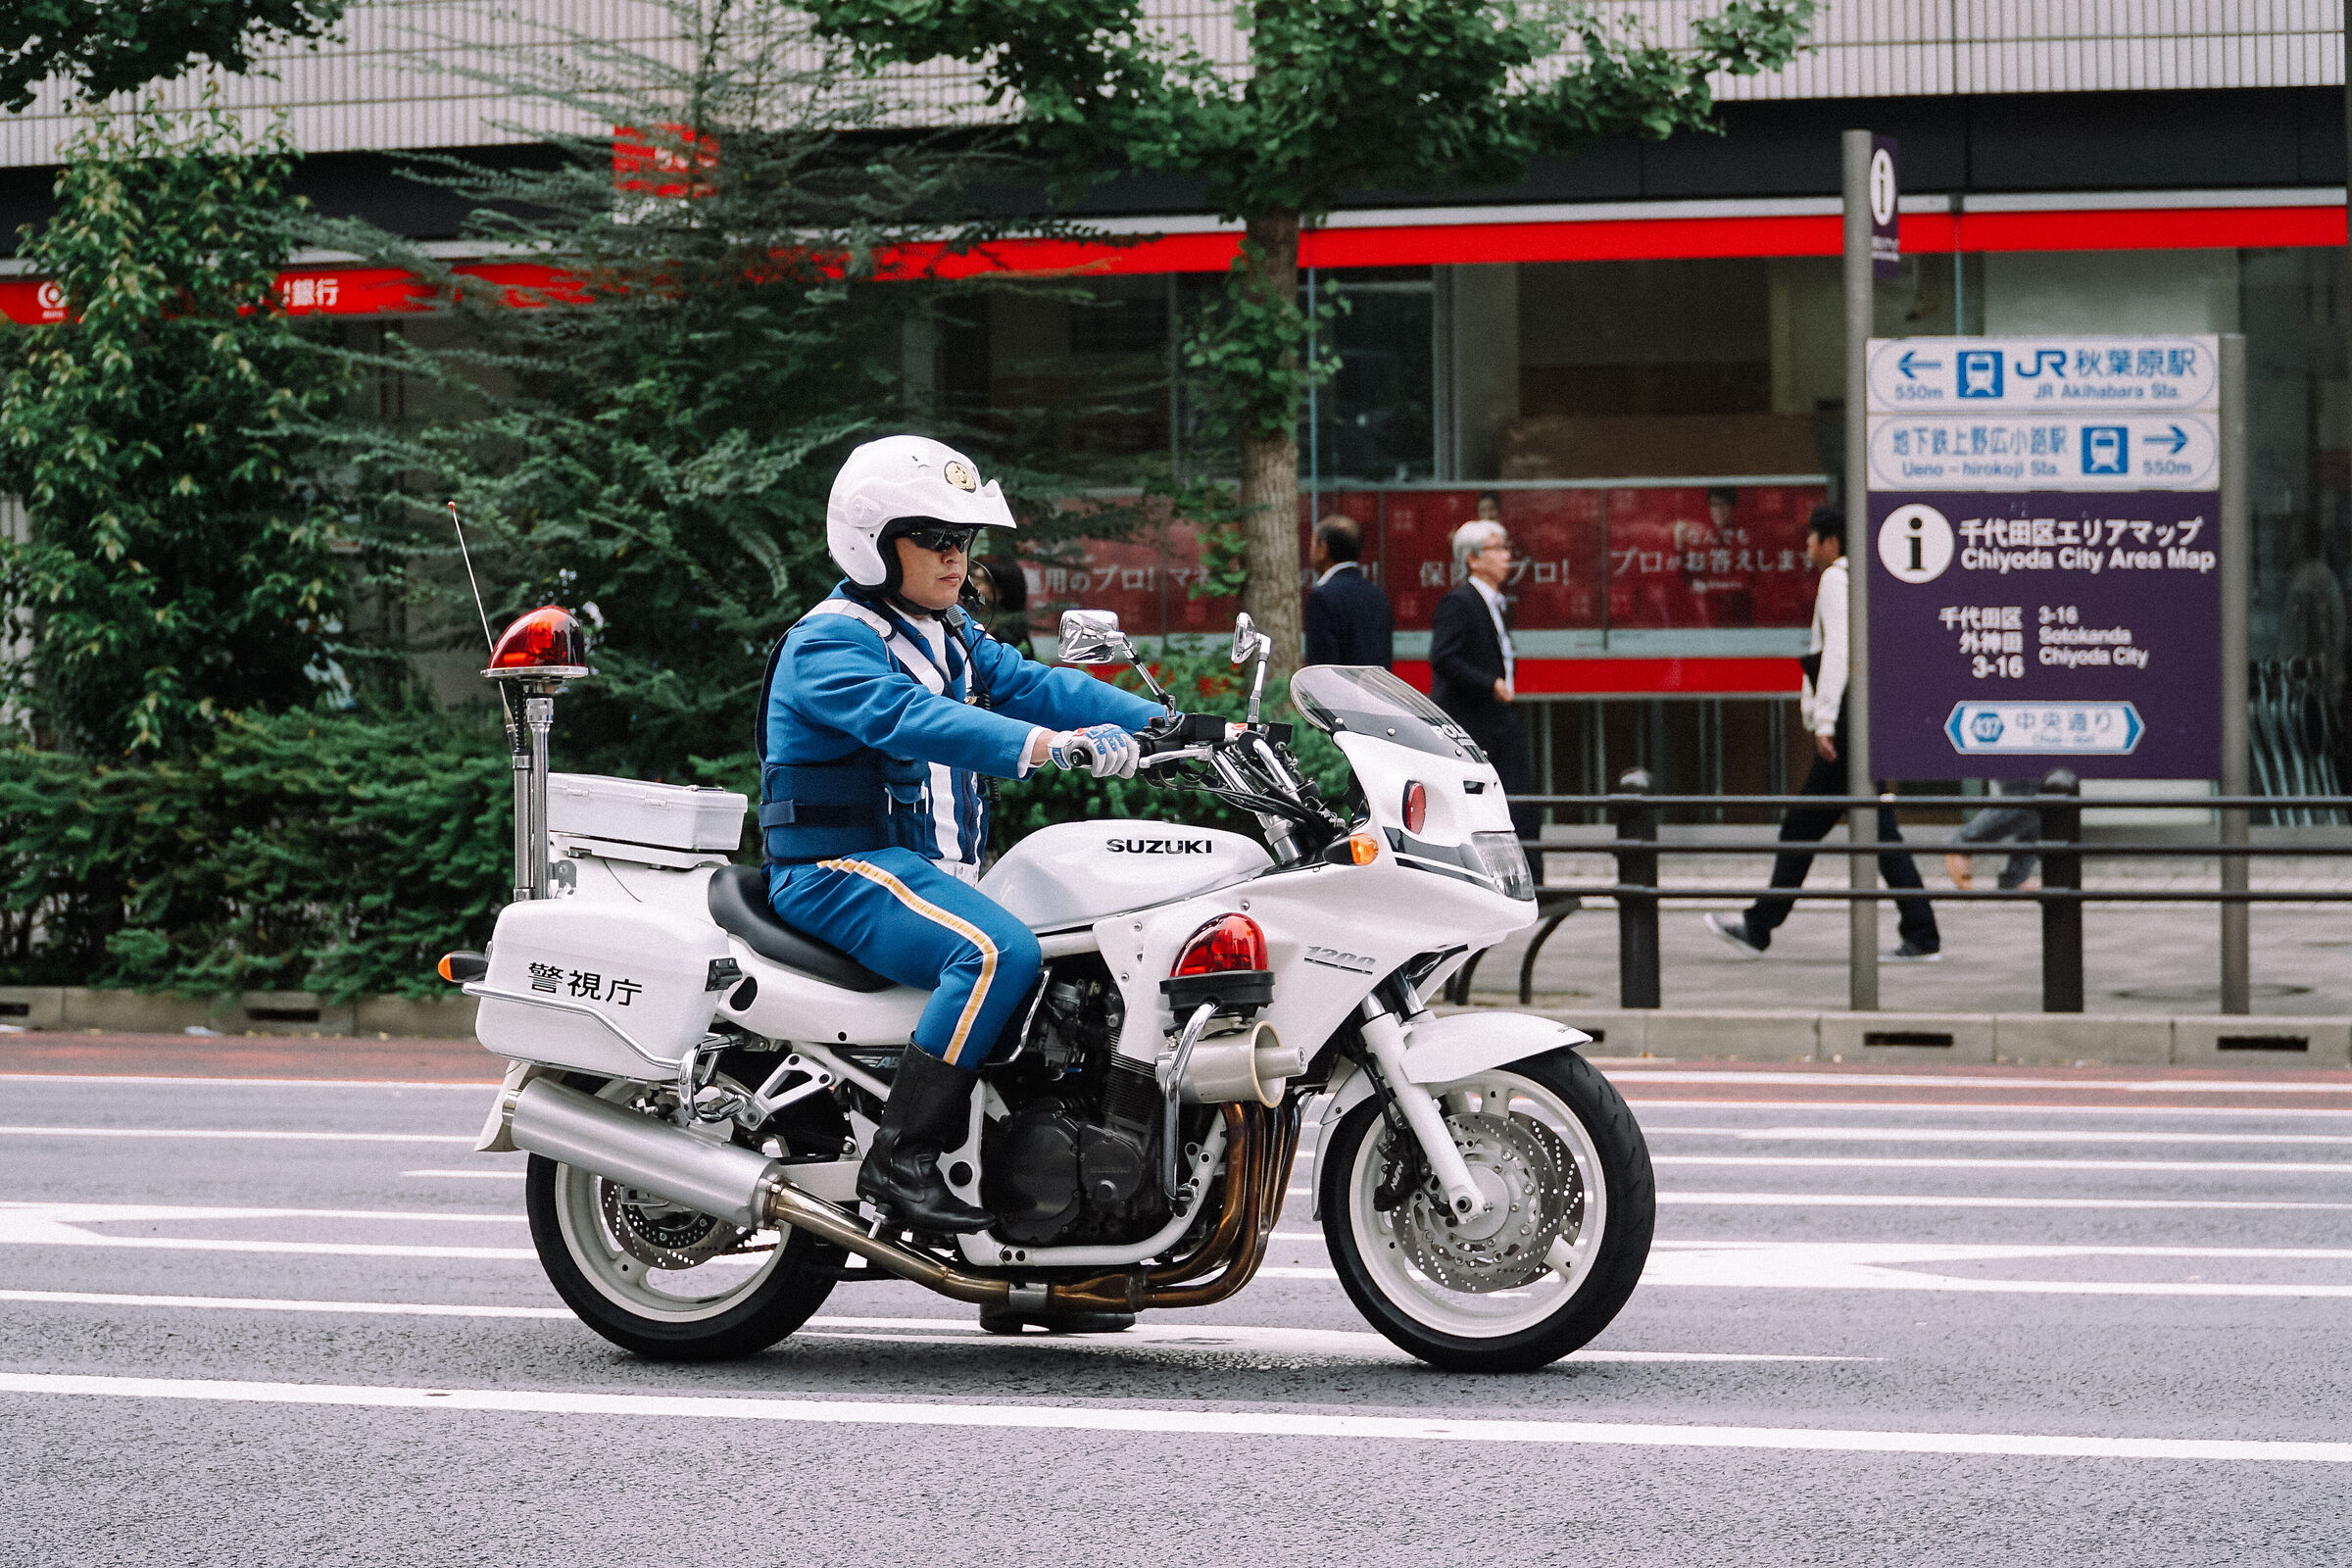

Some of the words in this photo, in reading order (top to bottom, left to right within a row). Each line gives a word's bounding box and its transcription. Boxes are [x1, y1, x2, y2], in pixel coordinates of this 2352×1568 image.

[2016, 350, 2067, 377] JR
[2074, 348, 2198, 378] 秋葉原駅
[1894, 383, 1943, 400] 550m
[2034, 383, 2054, 400] JR
[2061, 382, 2144, 400] Akihabara
[2143, 461, 2192, 477] 550m
[1959, 516, 2204, 548] 千代田区エリアマップ
[1961, 548, 2055, 574] Chiyoda
[2058, 548, 2104, 574] City
[2109, 548, 2162, 569] Area
[2167, 548, 2217, 574] Map
[1938, 606, 2023, 630] 千代田区
[1959, 630, 2023, 655] 外神田
[2038, 625, 2132, 645] Sotokanda
[1972, 655, 2026, 678] 3-16
[2038, 646, 2111, 669] Chiyoda
[2113, 646, 2149, 669] City
[1106, 838, 1212, 855] SUZUKI
[1305, 946, 1376, 968] 1200
[528, 961, 642, 1005] 警視庁
